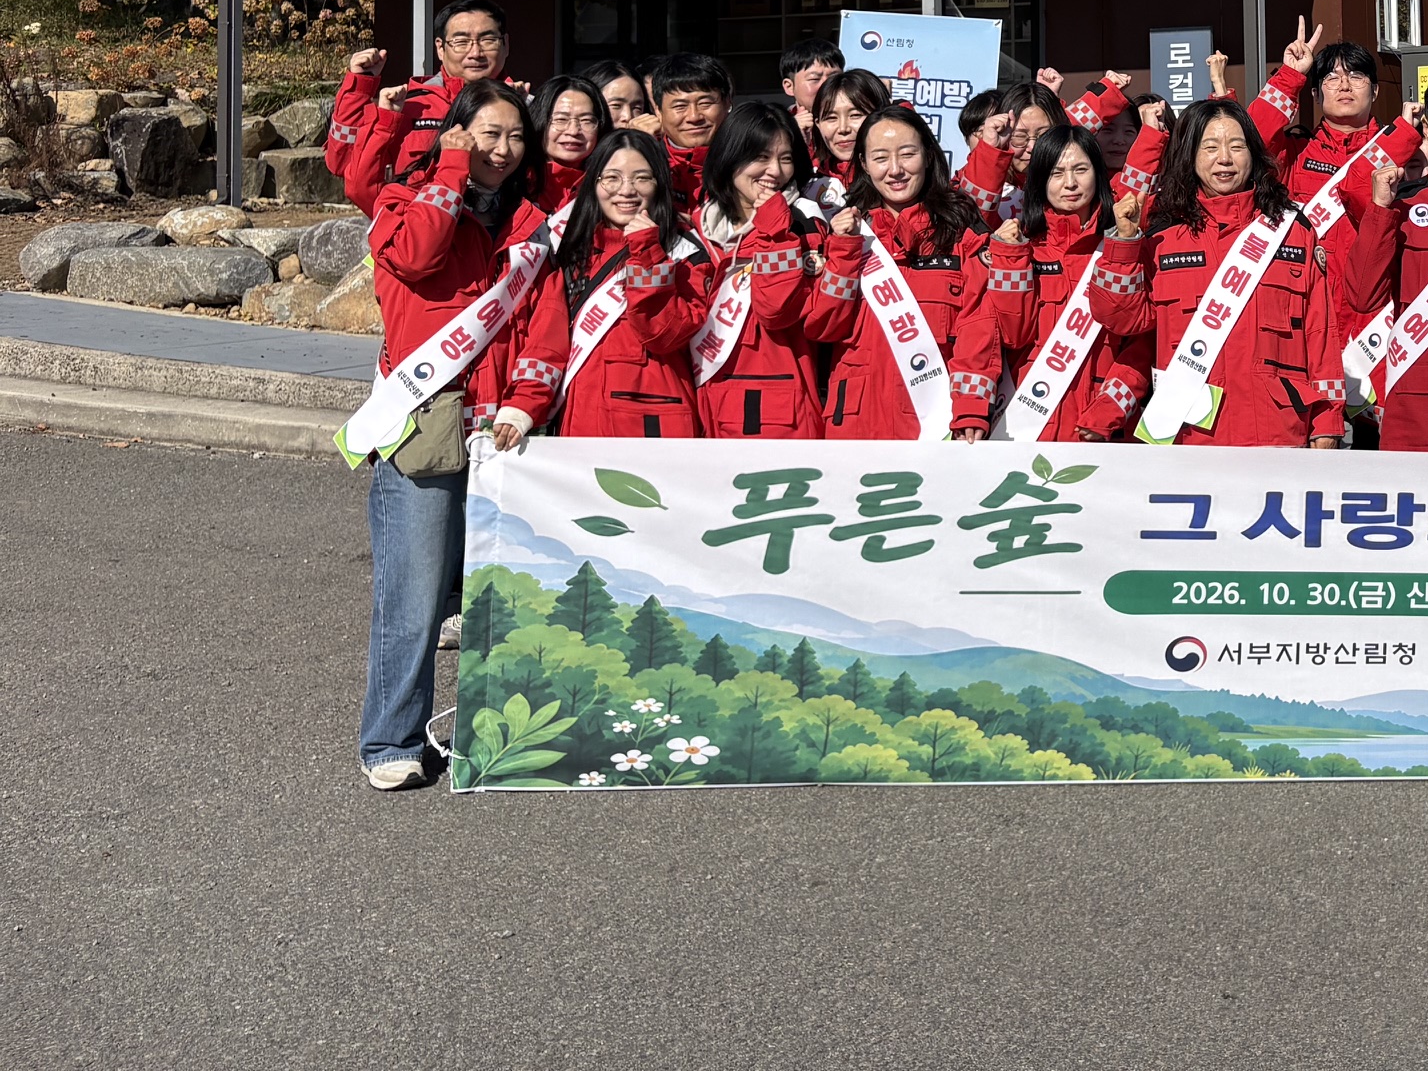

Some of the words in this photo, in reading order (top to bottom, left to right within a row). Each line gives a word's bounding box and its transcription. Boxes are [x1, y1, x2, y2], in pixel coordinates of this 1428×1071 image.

[886, 37, 915, 49] 산림청
[889, 78, 973, 108] 불예방
[440, 242, 541, 361] 산불예방
[1046, 282, 1094, 372] 예방
[910, 367, 943, 388] 서부지방산림청
[1177, 353, 1208, 376] 서부지방산림청
[396, 369, 424, 400] 서부지방산림청
[1017, 393, 1049, 416] 서부지방산림청
[701, 467, 943, 575] 푸른
[957, 470, 1083, 570] 숲
[1140, 493, 1217, 540] 그
[1171, 580, 1247, 606] 2026.
[1259, 582, 1296, 607] 10.
[1307, 581, 1396, 610] 30.(금)
[1217, 640, 1417, 667] 서부지방산림청
